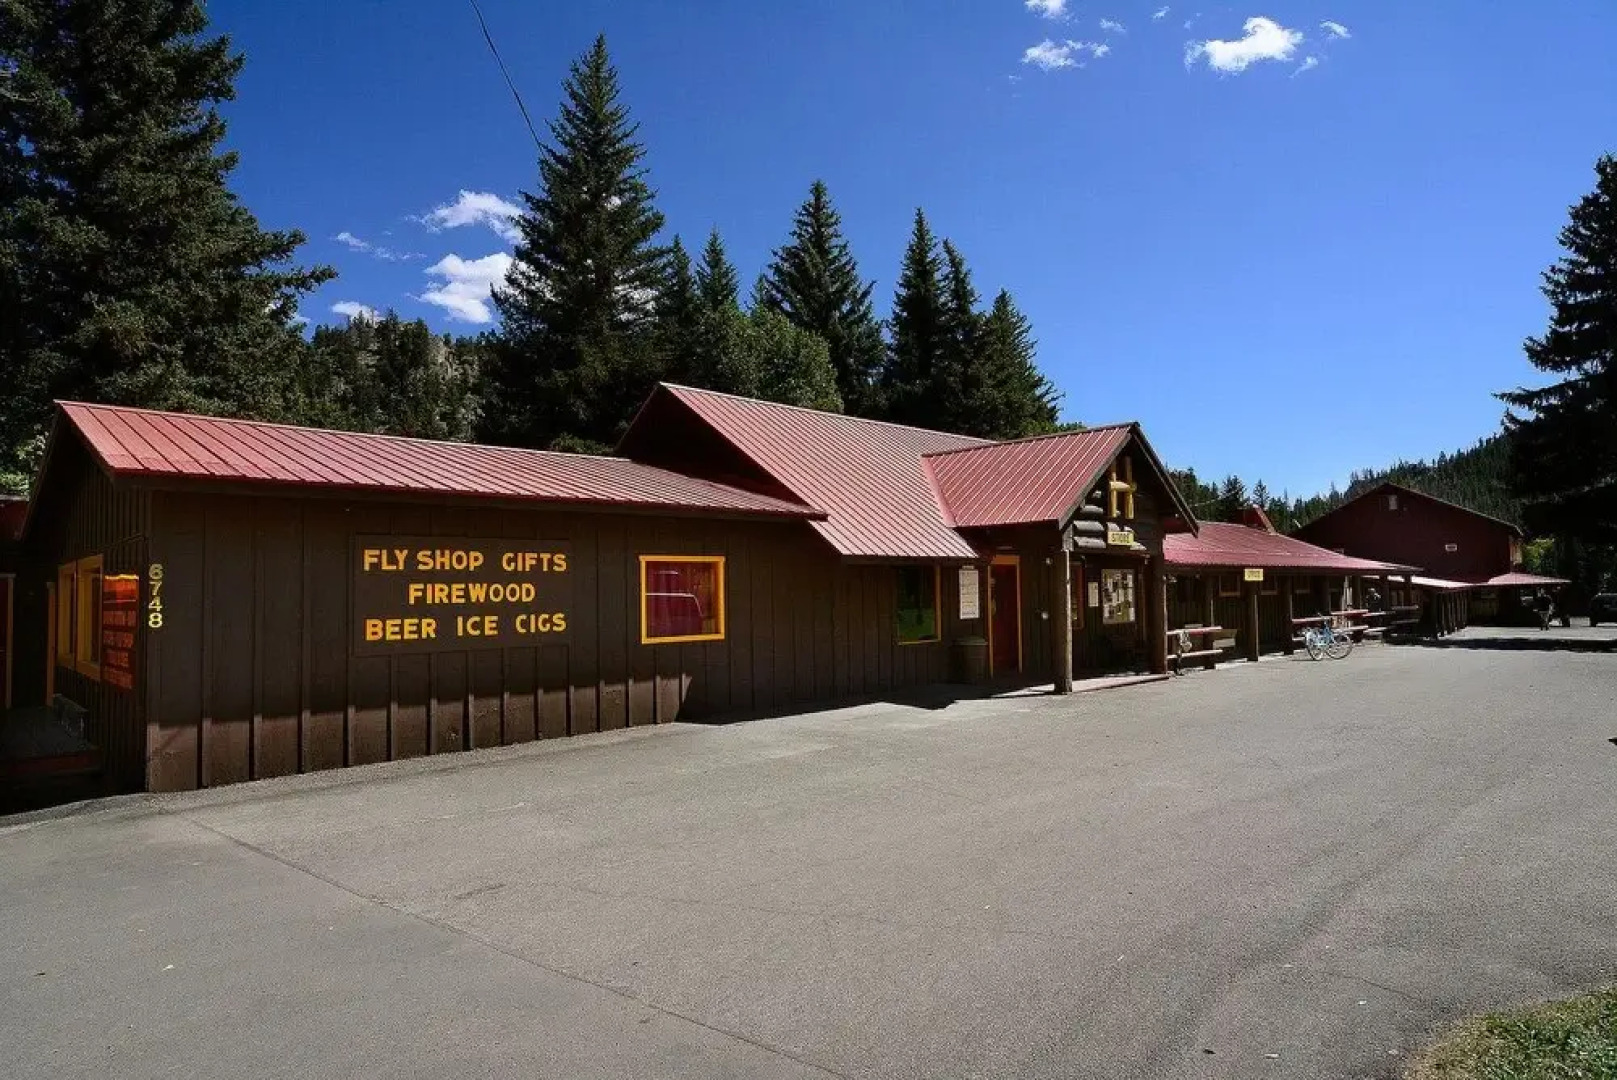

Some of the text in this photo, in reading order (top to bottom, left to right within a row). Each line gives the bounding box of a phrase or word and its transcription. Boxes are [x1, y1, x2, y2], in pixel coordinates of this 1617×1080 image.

[363, 549, 567, 572] FLY SHOP GIFTS
[148, 563, 163, 628] 6748
[408, 583, 536, 605] FIREWOOD
[365, 613, 567, 641] BEER ICE CIGS
